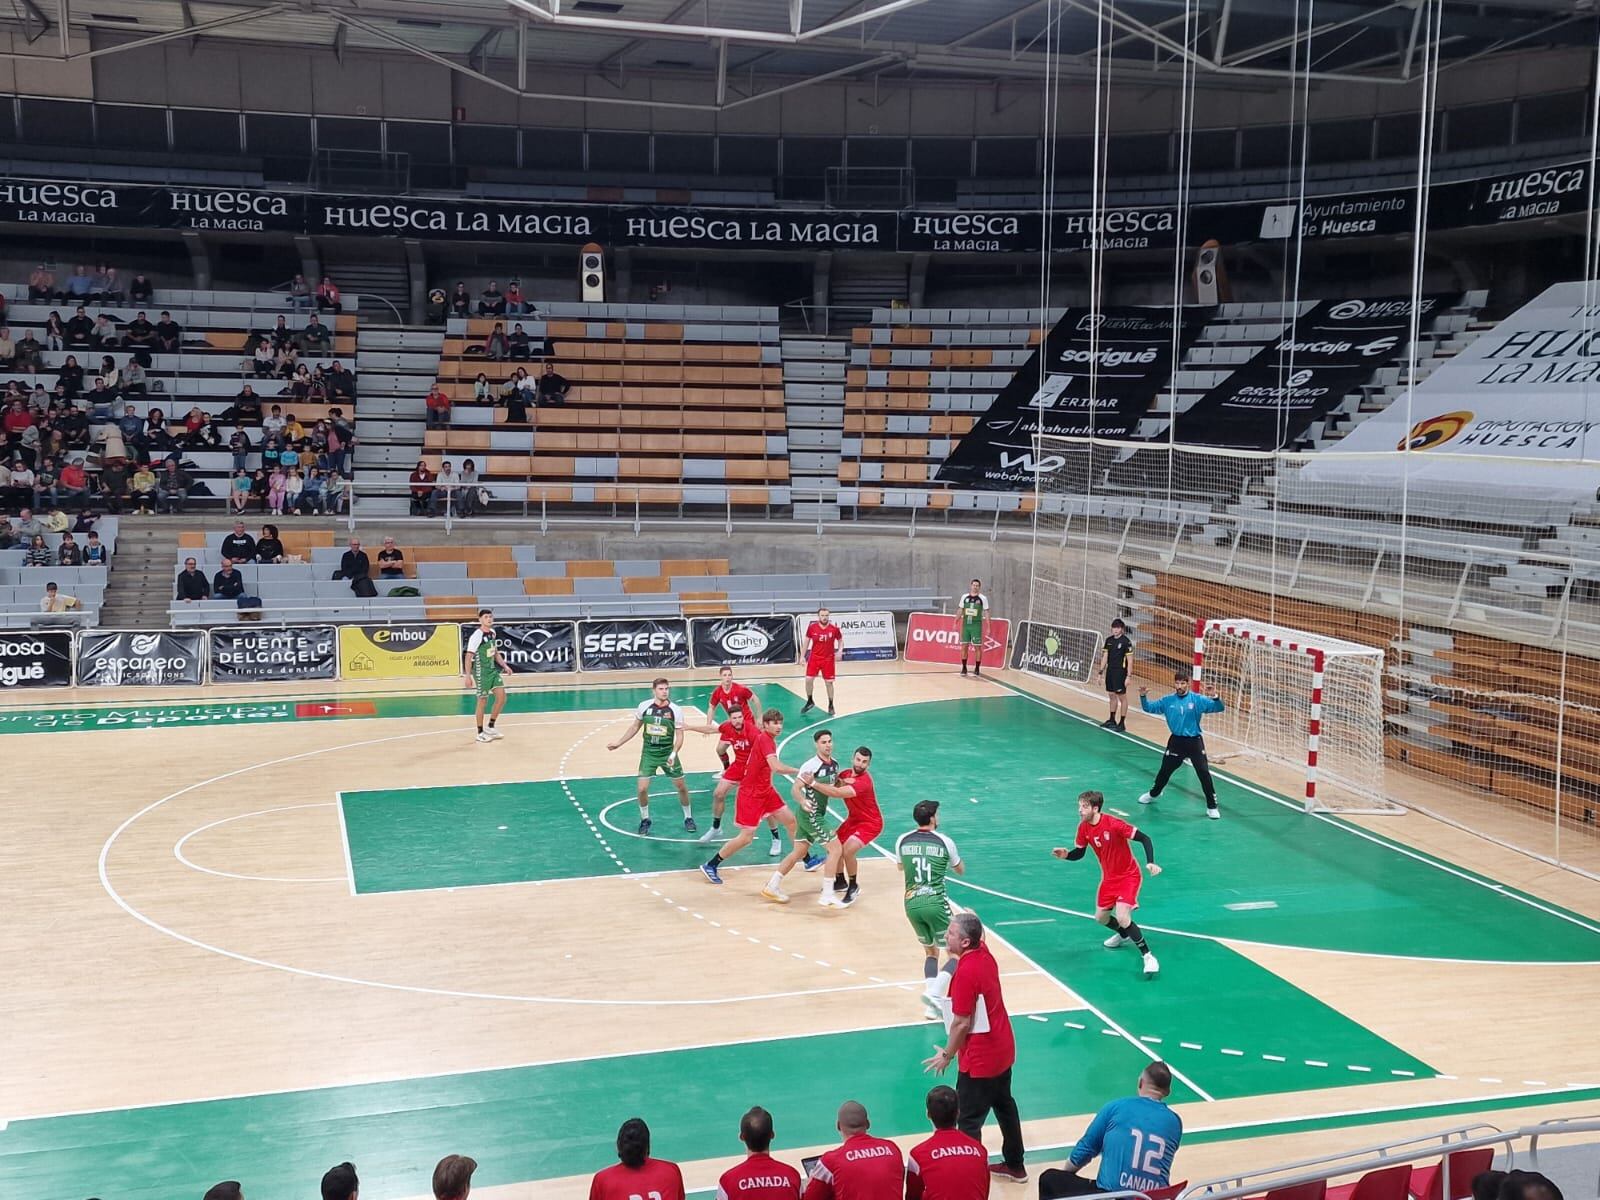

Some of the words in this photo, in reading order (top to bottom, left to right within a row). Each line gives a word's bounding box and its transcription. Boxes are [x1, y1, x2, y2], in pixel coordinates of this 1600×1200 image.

[1302, 197, 1406, 219] Ayuntamiento
[1321, 218, 1377, 236] Huesca
[1458, 432, 1578, 449] HUESCA
[233, 637, 308, 650] FUENTE
[372, 627, 428, 643] embou
[584, 632, 684, 653] SERFEY
[912, 628, 961, 645] avan
[95, 657, 187, 670] escanero
[279, 665, 322, 674] dental
[1019, 650, 1080, 672] podoactiva
[107, 703, 288, 718] Municipal
[33, 719, 85, 728] de
[97, 711, 289, 725] Deportes
[911, 857, 932, 883] 34
[845, 1145, 894, 1162] CANADA
[931, 1144, 982, 1160] CANADA
[1131, 1128, 1166, 1176] 12
[738, 1175, 791, 1191] CANADA
[1119, 1171, 1161, 1191] CANADA
